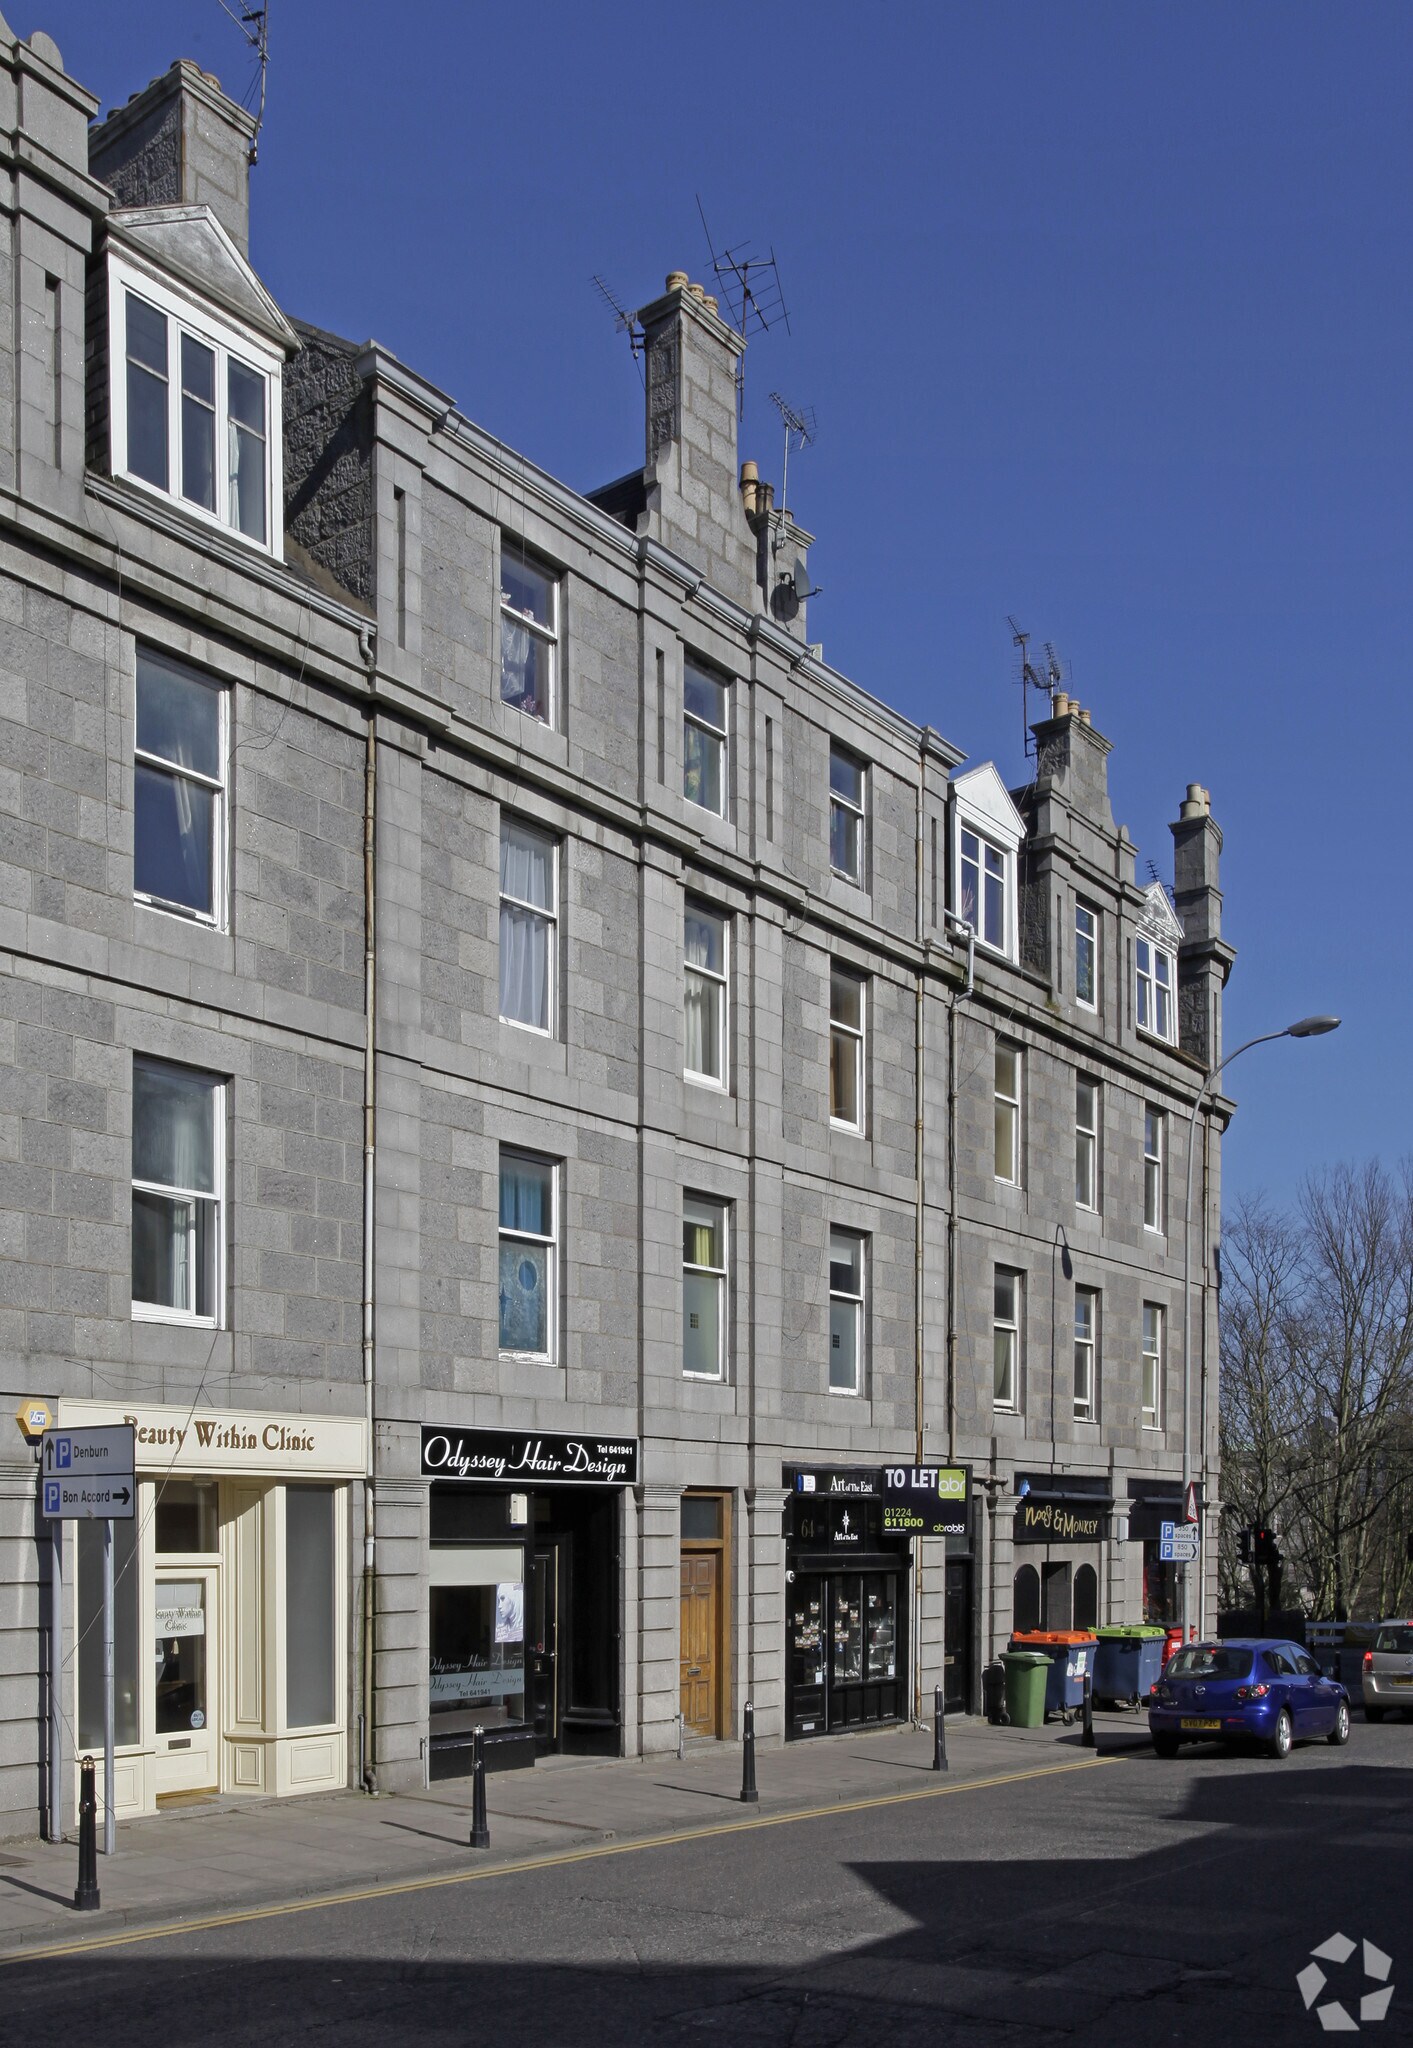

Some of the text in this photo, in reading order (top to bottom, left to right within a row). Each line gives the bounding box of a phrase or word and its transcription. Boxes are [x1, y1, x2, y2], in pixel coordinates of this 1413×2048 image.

[30, 1411, 46, 1424] ADT
[194, 1420, 257, 1449] Within
[262, 1424, 315, 1451] Clinic
[73, 1445, 109, 1458] Denburn
[597, 1445, 633, 1454] Tel 641941
[424, 1436, 627, 1481] Odyssey Hair Design
[830, 1476, 845, 1492] Art
[860, 1481, 873, 1493] East
[885, 1469, 938, 1488] TO LET
[63, 1491, 78, 1503] Bon
[81, 1490, 110, 1503] Accord
[884, 1508, 912, 1517] 01224
[884, 1518, 923, 1527] 611800
[1053, 1509, 1064, 1532] &
